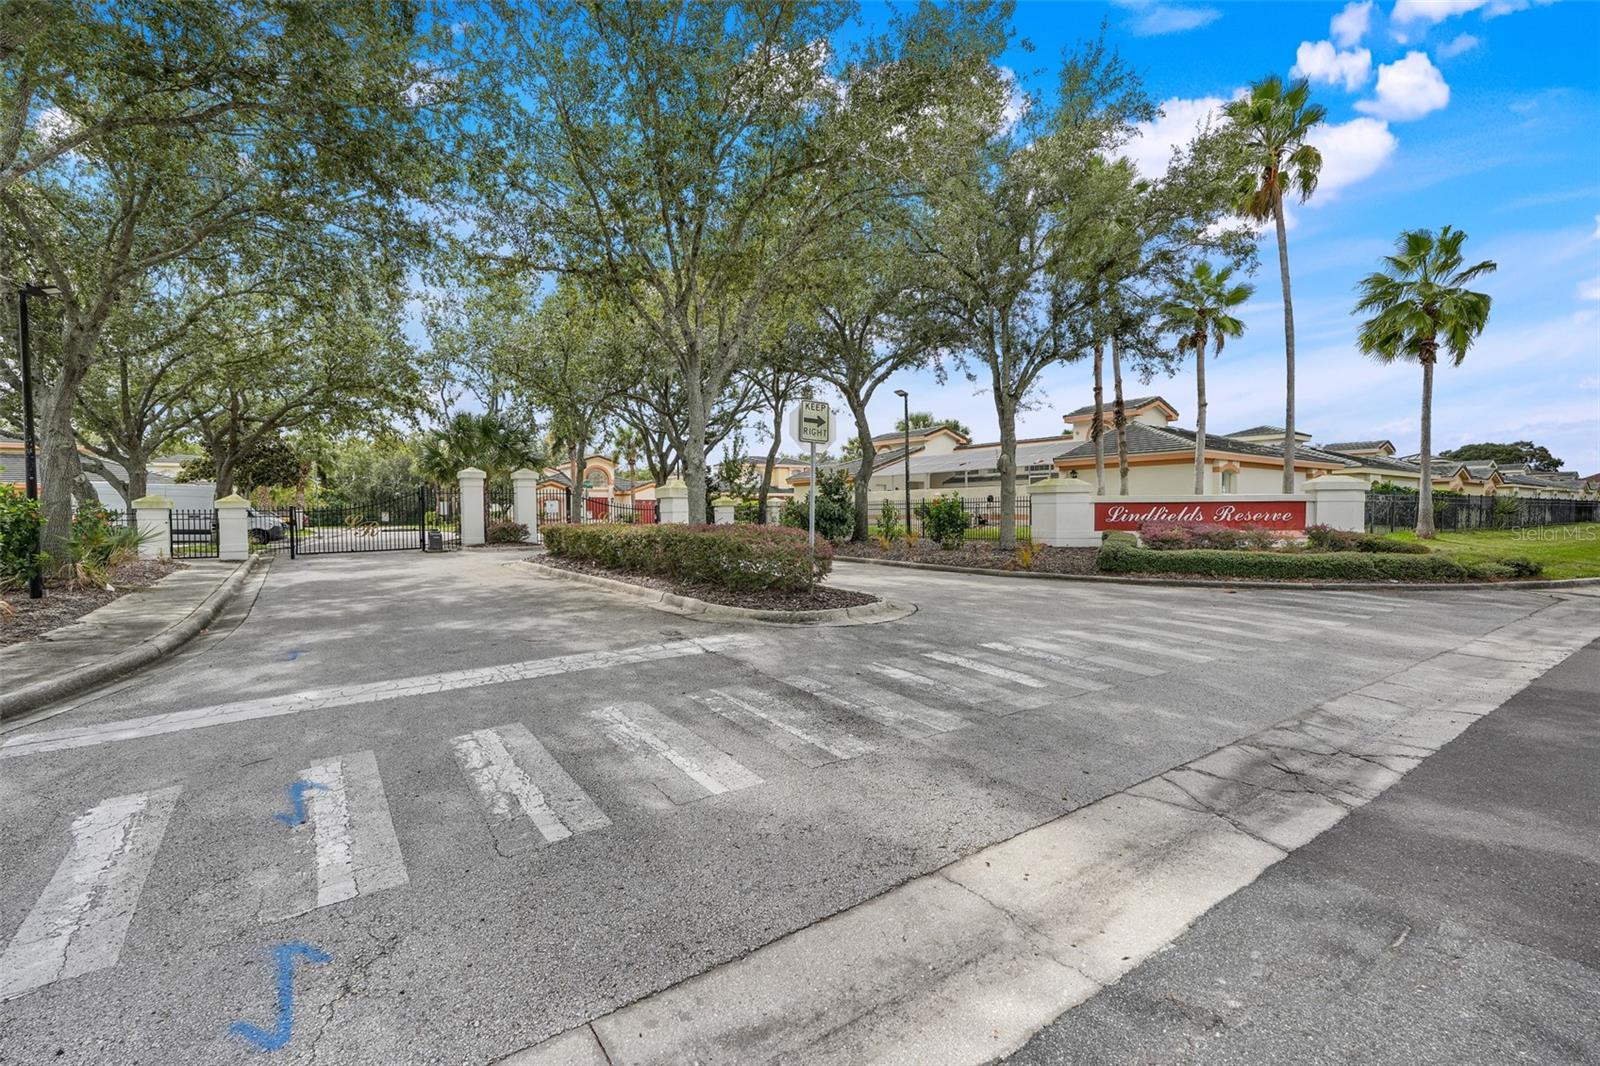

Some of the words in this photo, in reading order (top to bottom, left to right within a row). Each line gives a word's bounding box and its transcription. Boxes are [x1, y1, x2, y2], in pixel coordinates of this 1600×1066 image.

[805, 402, 826, 411] KEEP
[804, 427, 827, 437] RIGHT
[1105, 506, 1204, 522] Lindfields
[1213, 505, 1293, 521] Reserve
